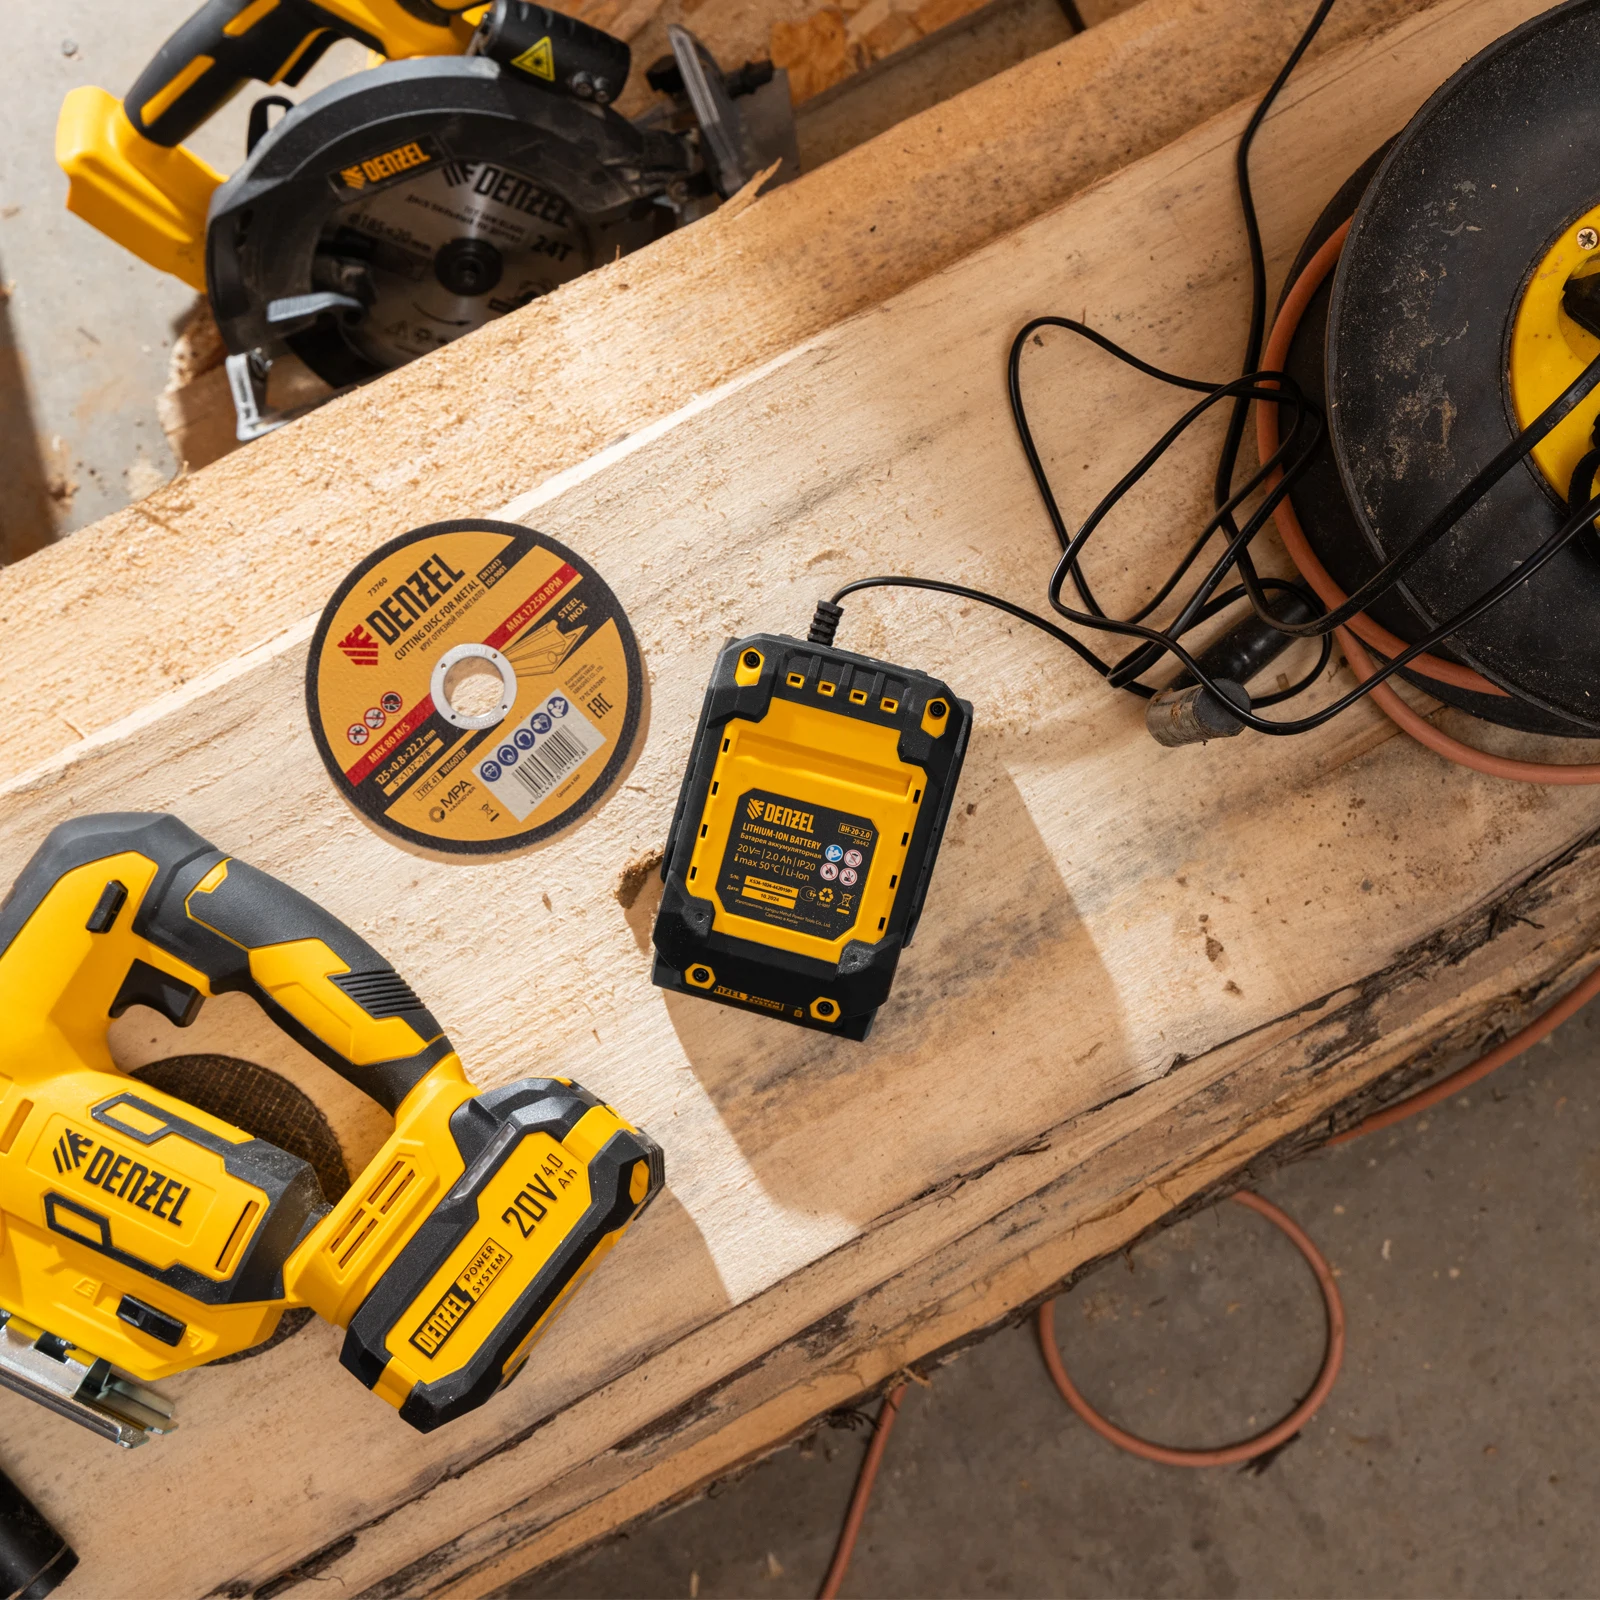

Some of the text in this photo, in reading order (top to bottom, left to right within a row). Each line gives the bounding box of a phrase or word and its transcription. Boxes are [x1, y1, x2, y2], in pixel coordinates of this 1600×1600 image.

[363, 143, 431, 183] DENZEL
[473, 165, 571, 228] DENZEL
[532, 233, 574, 263] 24T
[479, 559, 501, 580] EN12413
[485, 565, 507, 586] ISO 9001
[365, 553, 465, 645] DENZEL
[367, 577, 387, 596] 73760
[506, 577, 563, 632] MAX 12250 RPM
[558, 598, 580, 618] STEEL
[568, 603, 587, 622] INOX
[394, 580, 479, 660] CUTTING DISC FOR METAL
[420, 588, 485, 651] КРУГ ОТРЕЗНОЙ ПО МЕТАЛЛУ
[368, 722, 410, 763] MAX 80 M/S
[440, 748, 467, 774] WA60TBF
[417, 775, 440, 797] TYPE 41
[440, 780, 472, 808] MPA
[449, 786, 476, 812] HANNOVER
[763, 803, 814, 833] DENZEL
[841, 825, 870, 838] BH-20-2.0
[740, 832, 822, 859] Батарея аккумуляторная
[743, 822, 821, 850] LITHIUM-ION BATTERY
[739, 857, 757, 867] max
[765, 851, 779, 861] 2.0
[780, 855, 792, 864] Ah
[797, 859, 815, 871] IP20
[716, 986, 741, 998] NZEL
[749, 998, 779, 1009] SYSTEM
[83, 1145, 190, 1226] DENZEL
[559, 1169, 577, 1189] Ah
[501, 1153, 563, 1238] 20V 4.0
[463, 1245, 494, 1282] POWER
[472, 1253, 505, 1293] SYSTEM
[414, 1293, 470, 1354] DENZEL
